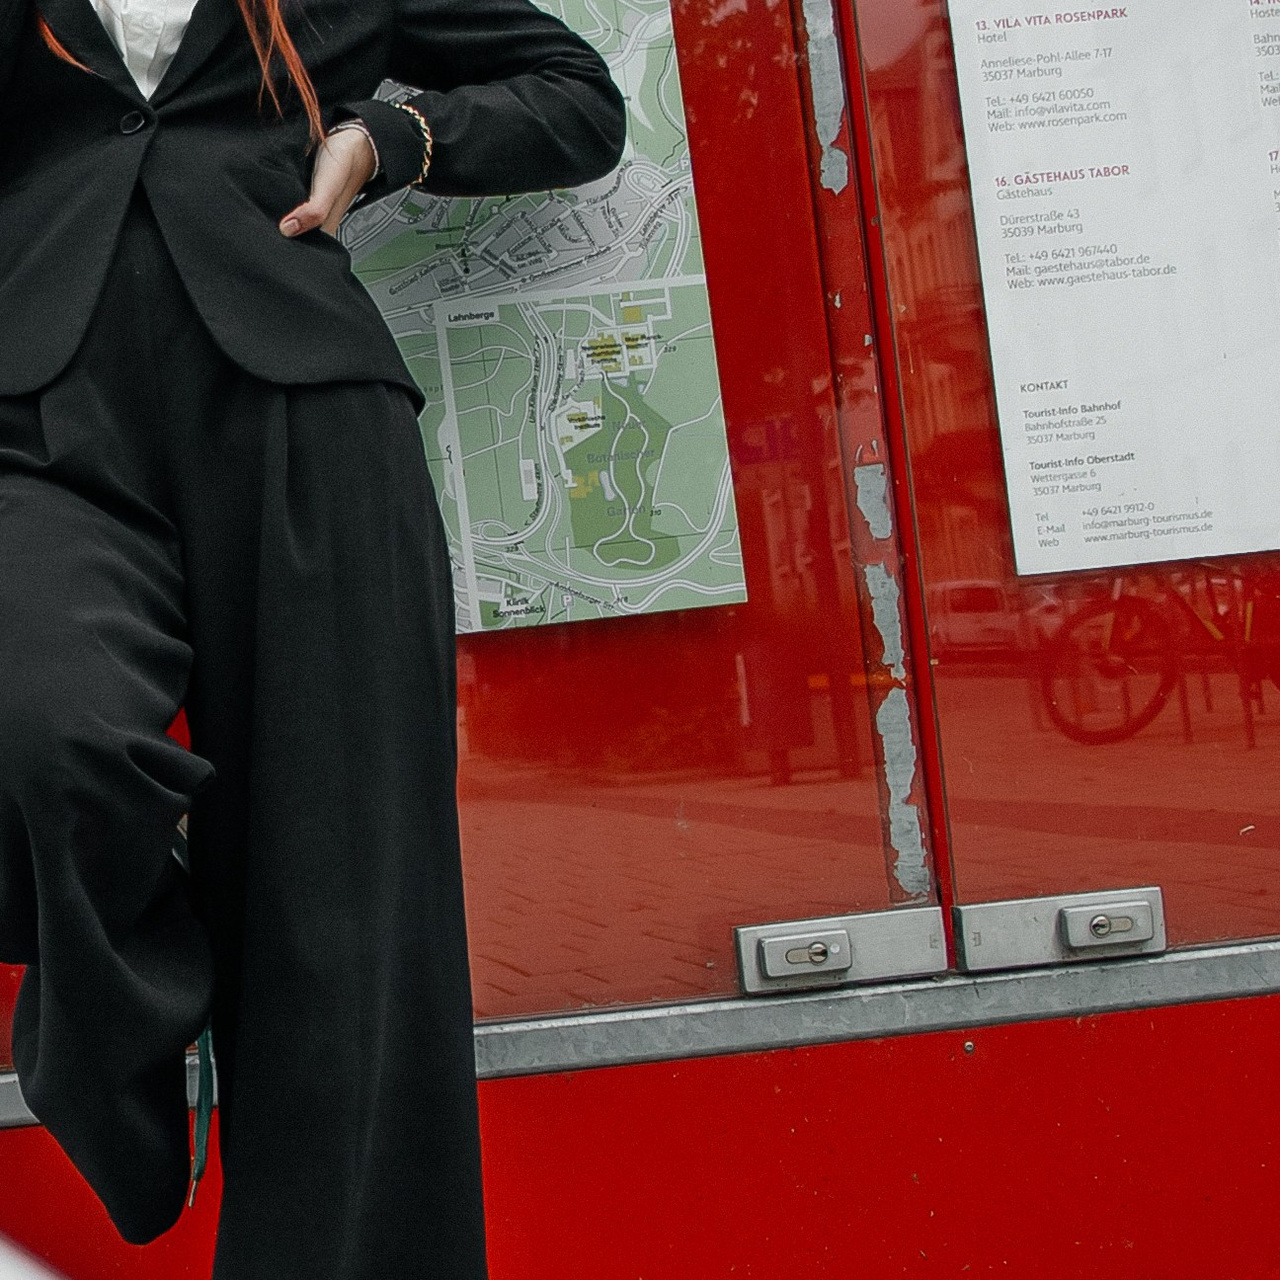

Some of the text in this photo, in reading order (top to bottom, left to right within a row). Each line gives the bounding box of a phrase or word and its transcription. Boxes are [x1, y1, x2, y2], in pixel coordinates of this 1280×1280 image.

[975, 6, 1128, 31] 13. VILA VITA ROSENPARK
[977, 30, 1007, 44] Hotel
[1093, 46, 1113, 59] 7-17
[982, 66, 1063, 82] 35037 Marburg
[994, 164, 1130, 187] 16. GÄSTEHAUS TABOR
[996, 186, 1053, 200] Gästehaus
[999, 208, 1080, 226] Dürerstraße 43
[1001, 222, 1083, 239] 35039 Marburg
[1019, 379, 1068, 393] KONTAKT
[1022, 399, 1121, 419] Tourist-Info Bahnhof
[1028, 451, 1135, 470] Tourist-Info Oberstadt
